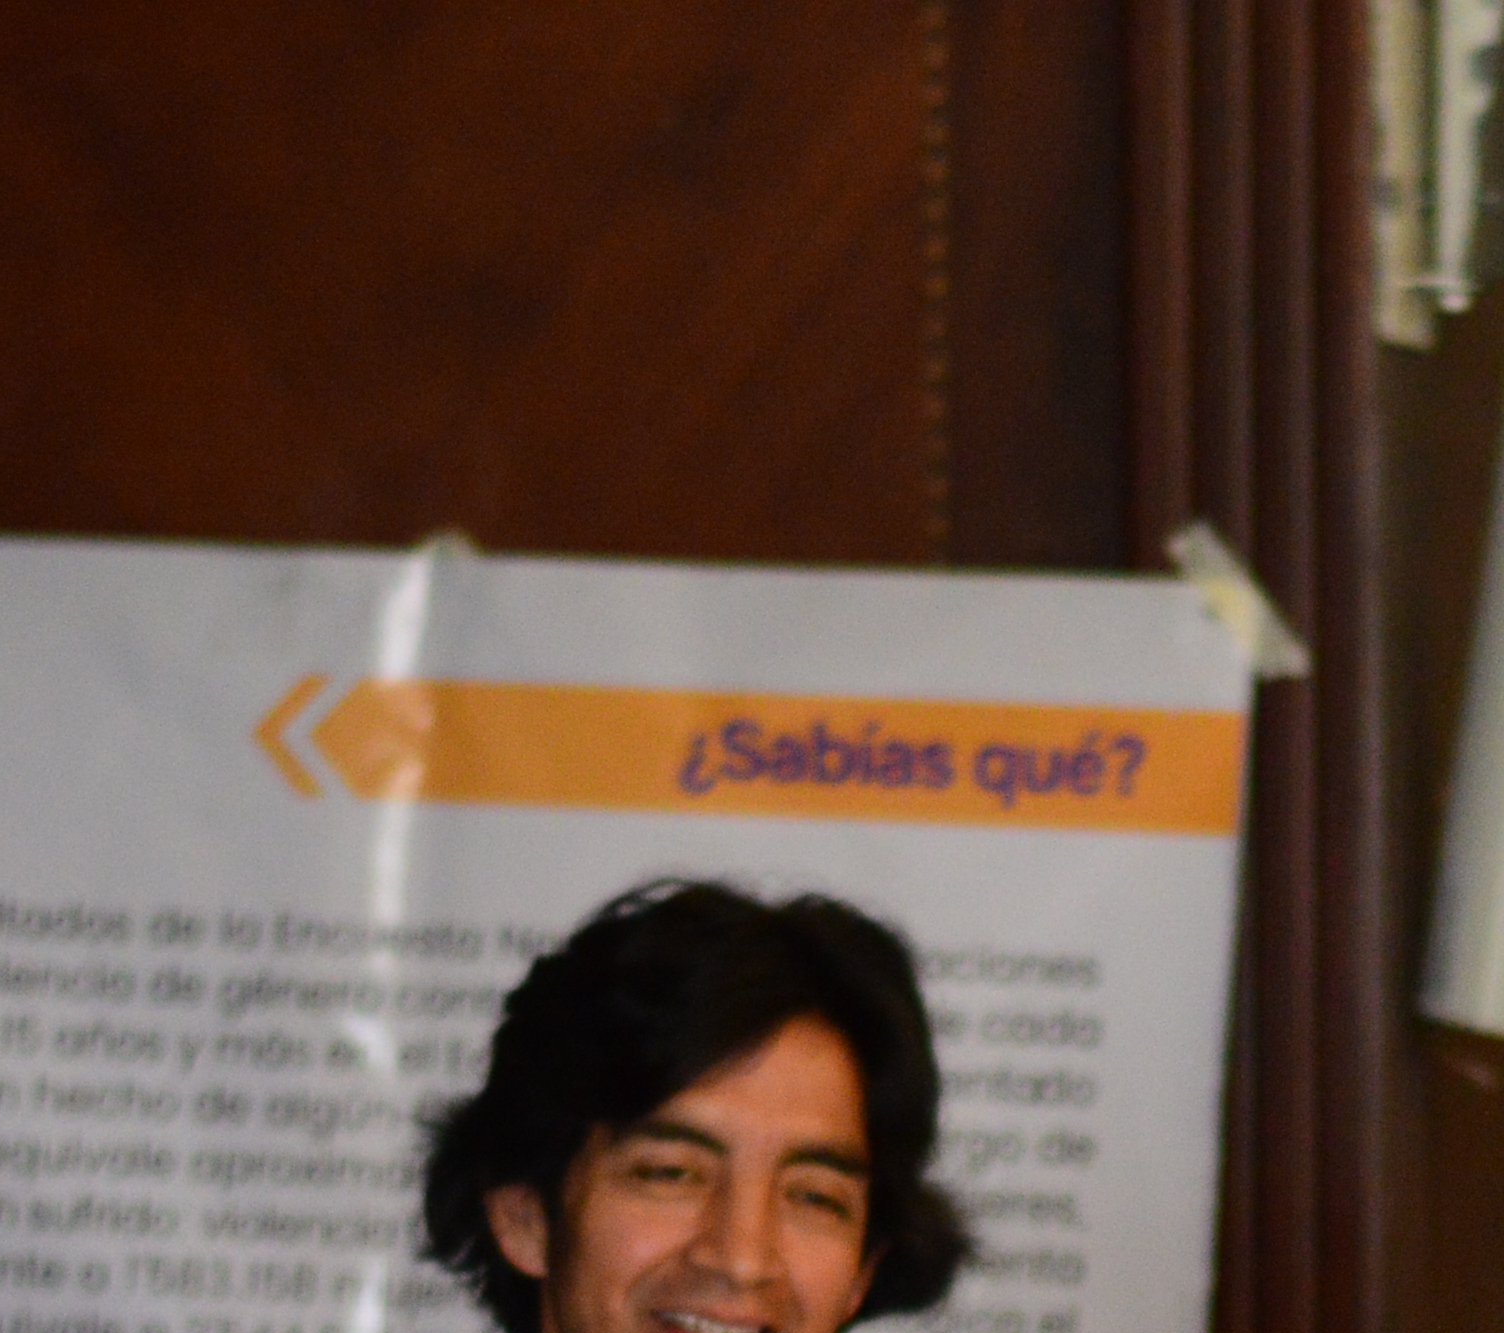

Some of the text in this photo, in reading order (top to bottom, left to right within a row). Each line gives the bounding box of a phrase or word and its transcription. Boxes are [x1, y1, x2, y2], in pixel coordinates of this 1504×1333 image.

[679, 719, 1147, 809] ¿Sabías qué?
[150, 902, 203, 946] de
[222, 908, 262, 948] la
[915, 950, 1100, 987] aciones
[54, 1020, 166, 1060] años
[178, 1032, 199, 1070] y
[215, 1029, 308, 1067] más
[150, 962, 203, 1004] de
[222, 965, 380, 1013] género
[980, 1008, 1104, 1048] cada
[34, 1071, 177, 1119] hecho
[194, 1079, 248, 1124] de
[265, 1085, 403, 1141] algún
[1037, 1129, 1097, 1166] de
[80, 1261, 111, 1292] a
